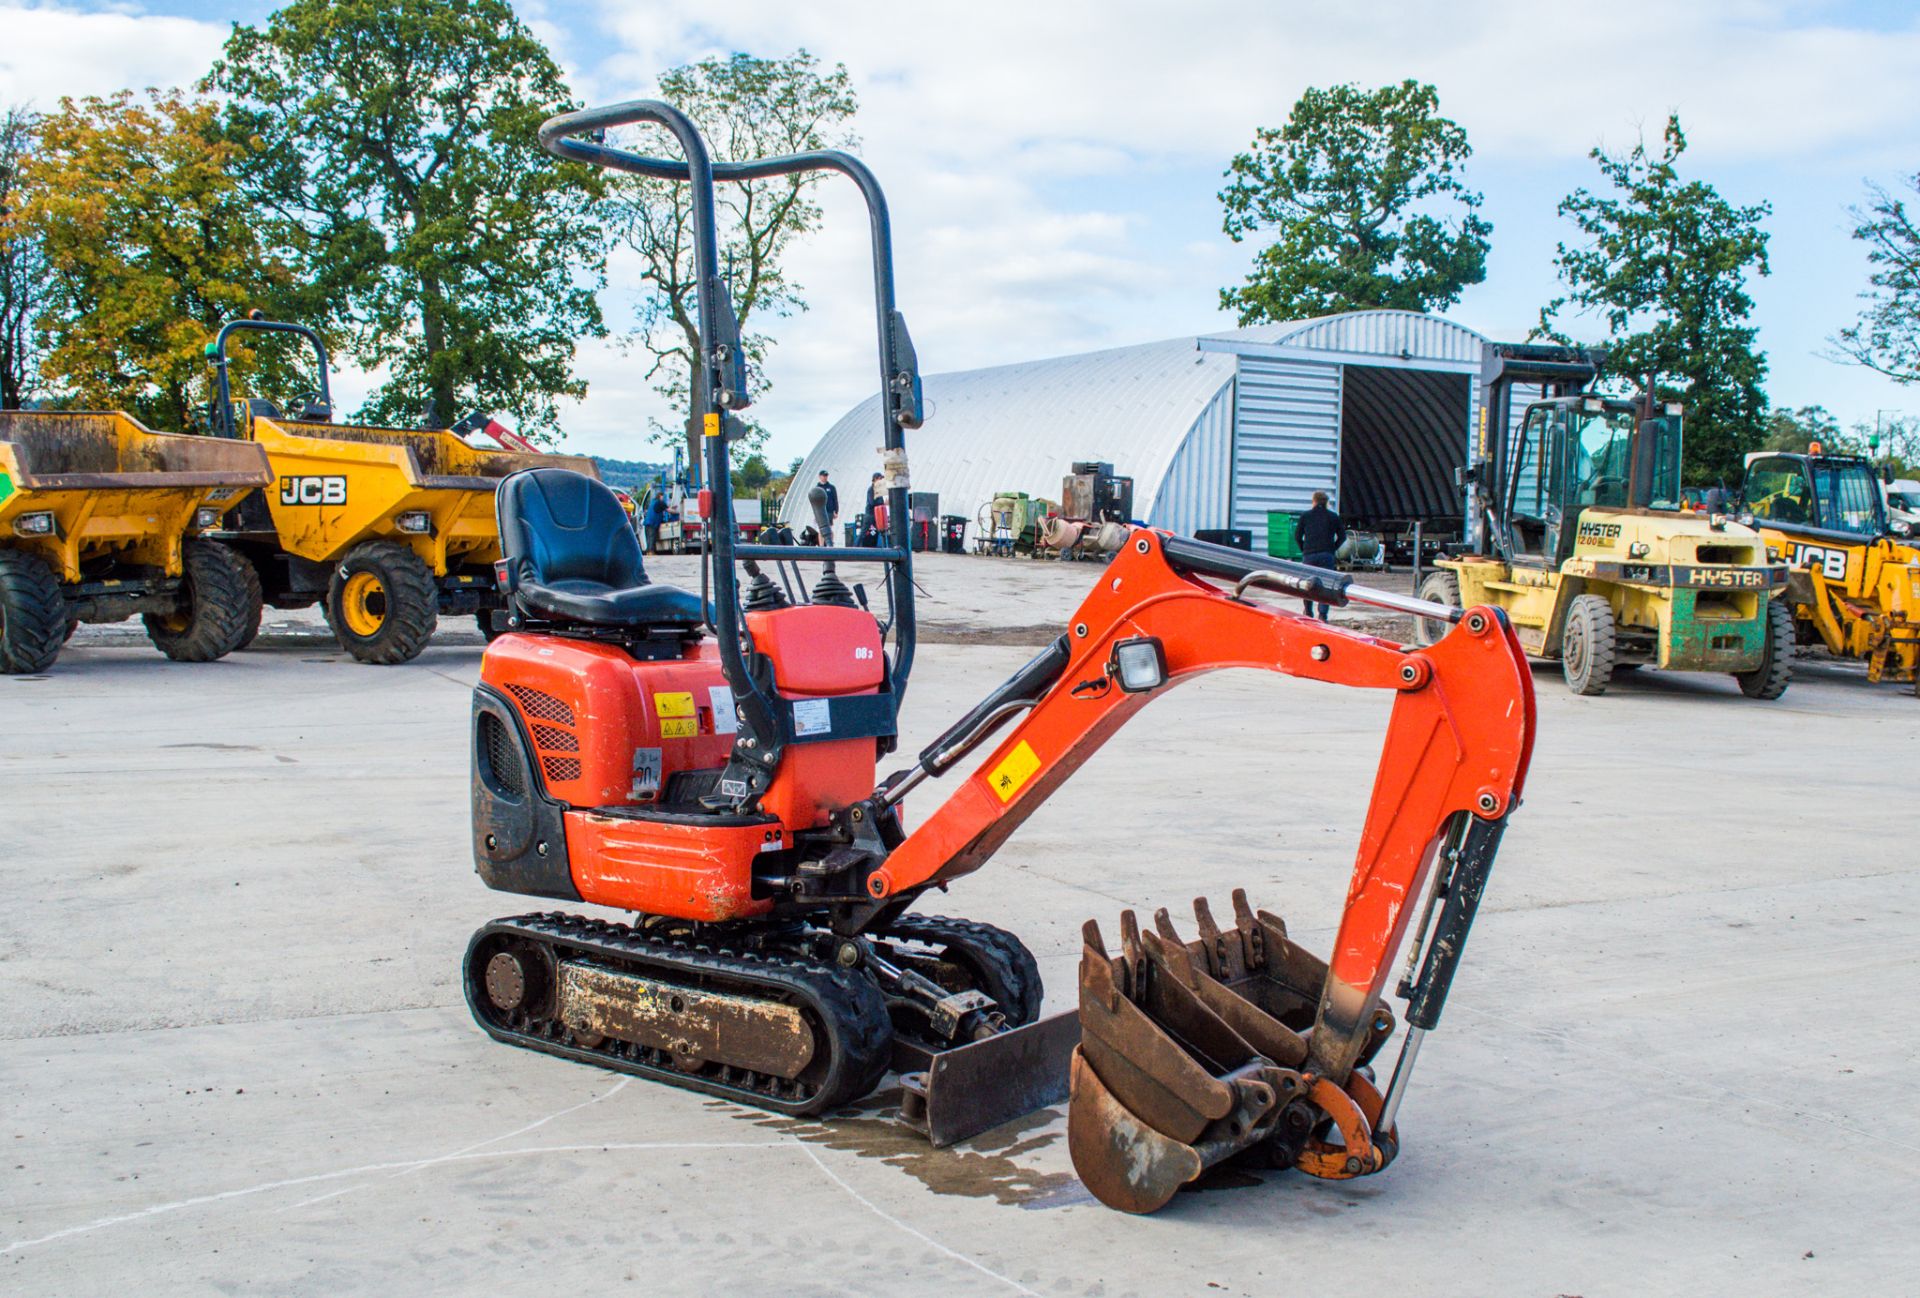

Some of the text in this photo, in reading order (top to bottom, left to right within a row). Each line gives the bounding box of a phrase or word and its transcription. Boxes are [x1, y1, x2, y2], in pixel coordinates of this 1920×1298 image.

[281, 476, 346, 504] JCB
[1579, 521, 1622, 538] HYSTER
[1689, 569, 1763, 586] HYSTER
